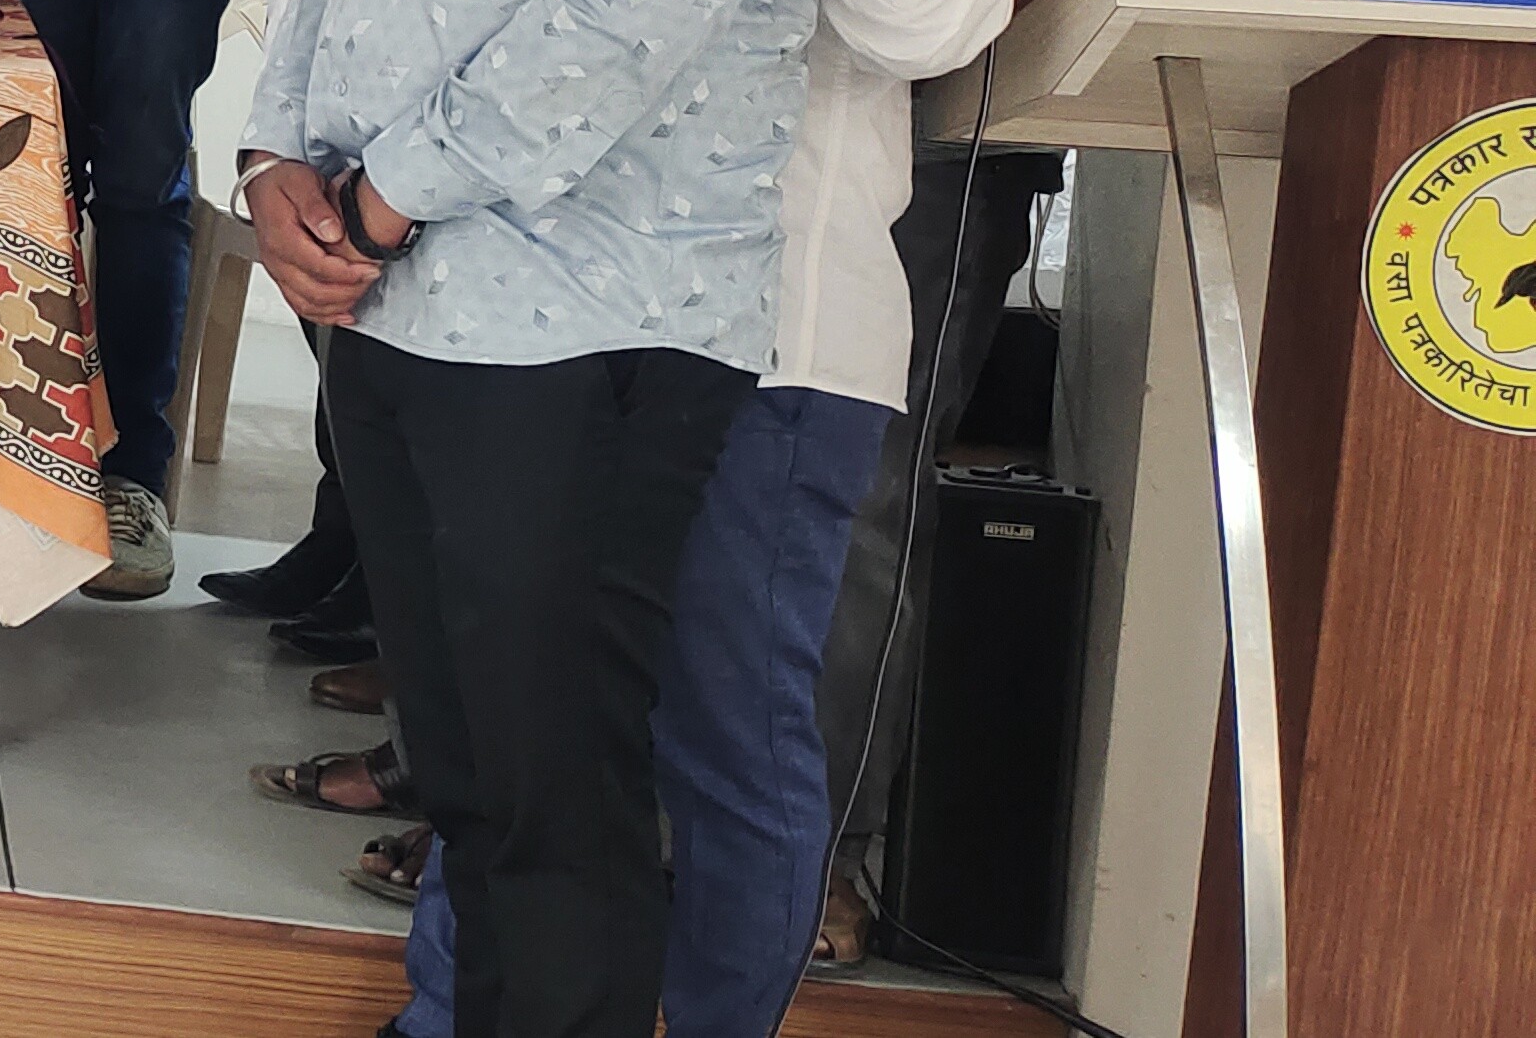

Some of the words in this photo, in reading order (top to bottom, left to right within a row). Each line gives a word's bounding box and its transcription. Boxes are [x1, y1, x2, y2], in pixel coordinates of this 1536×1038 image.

[1408, 133, 1508, 206] पत्रकार
[1386, 250, 1413, 302] वसा
[1401, 312, 1530, 407] पत्रकारितेचा
